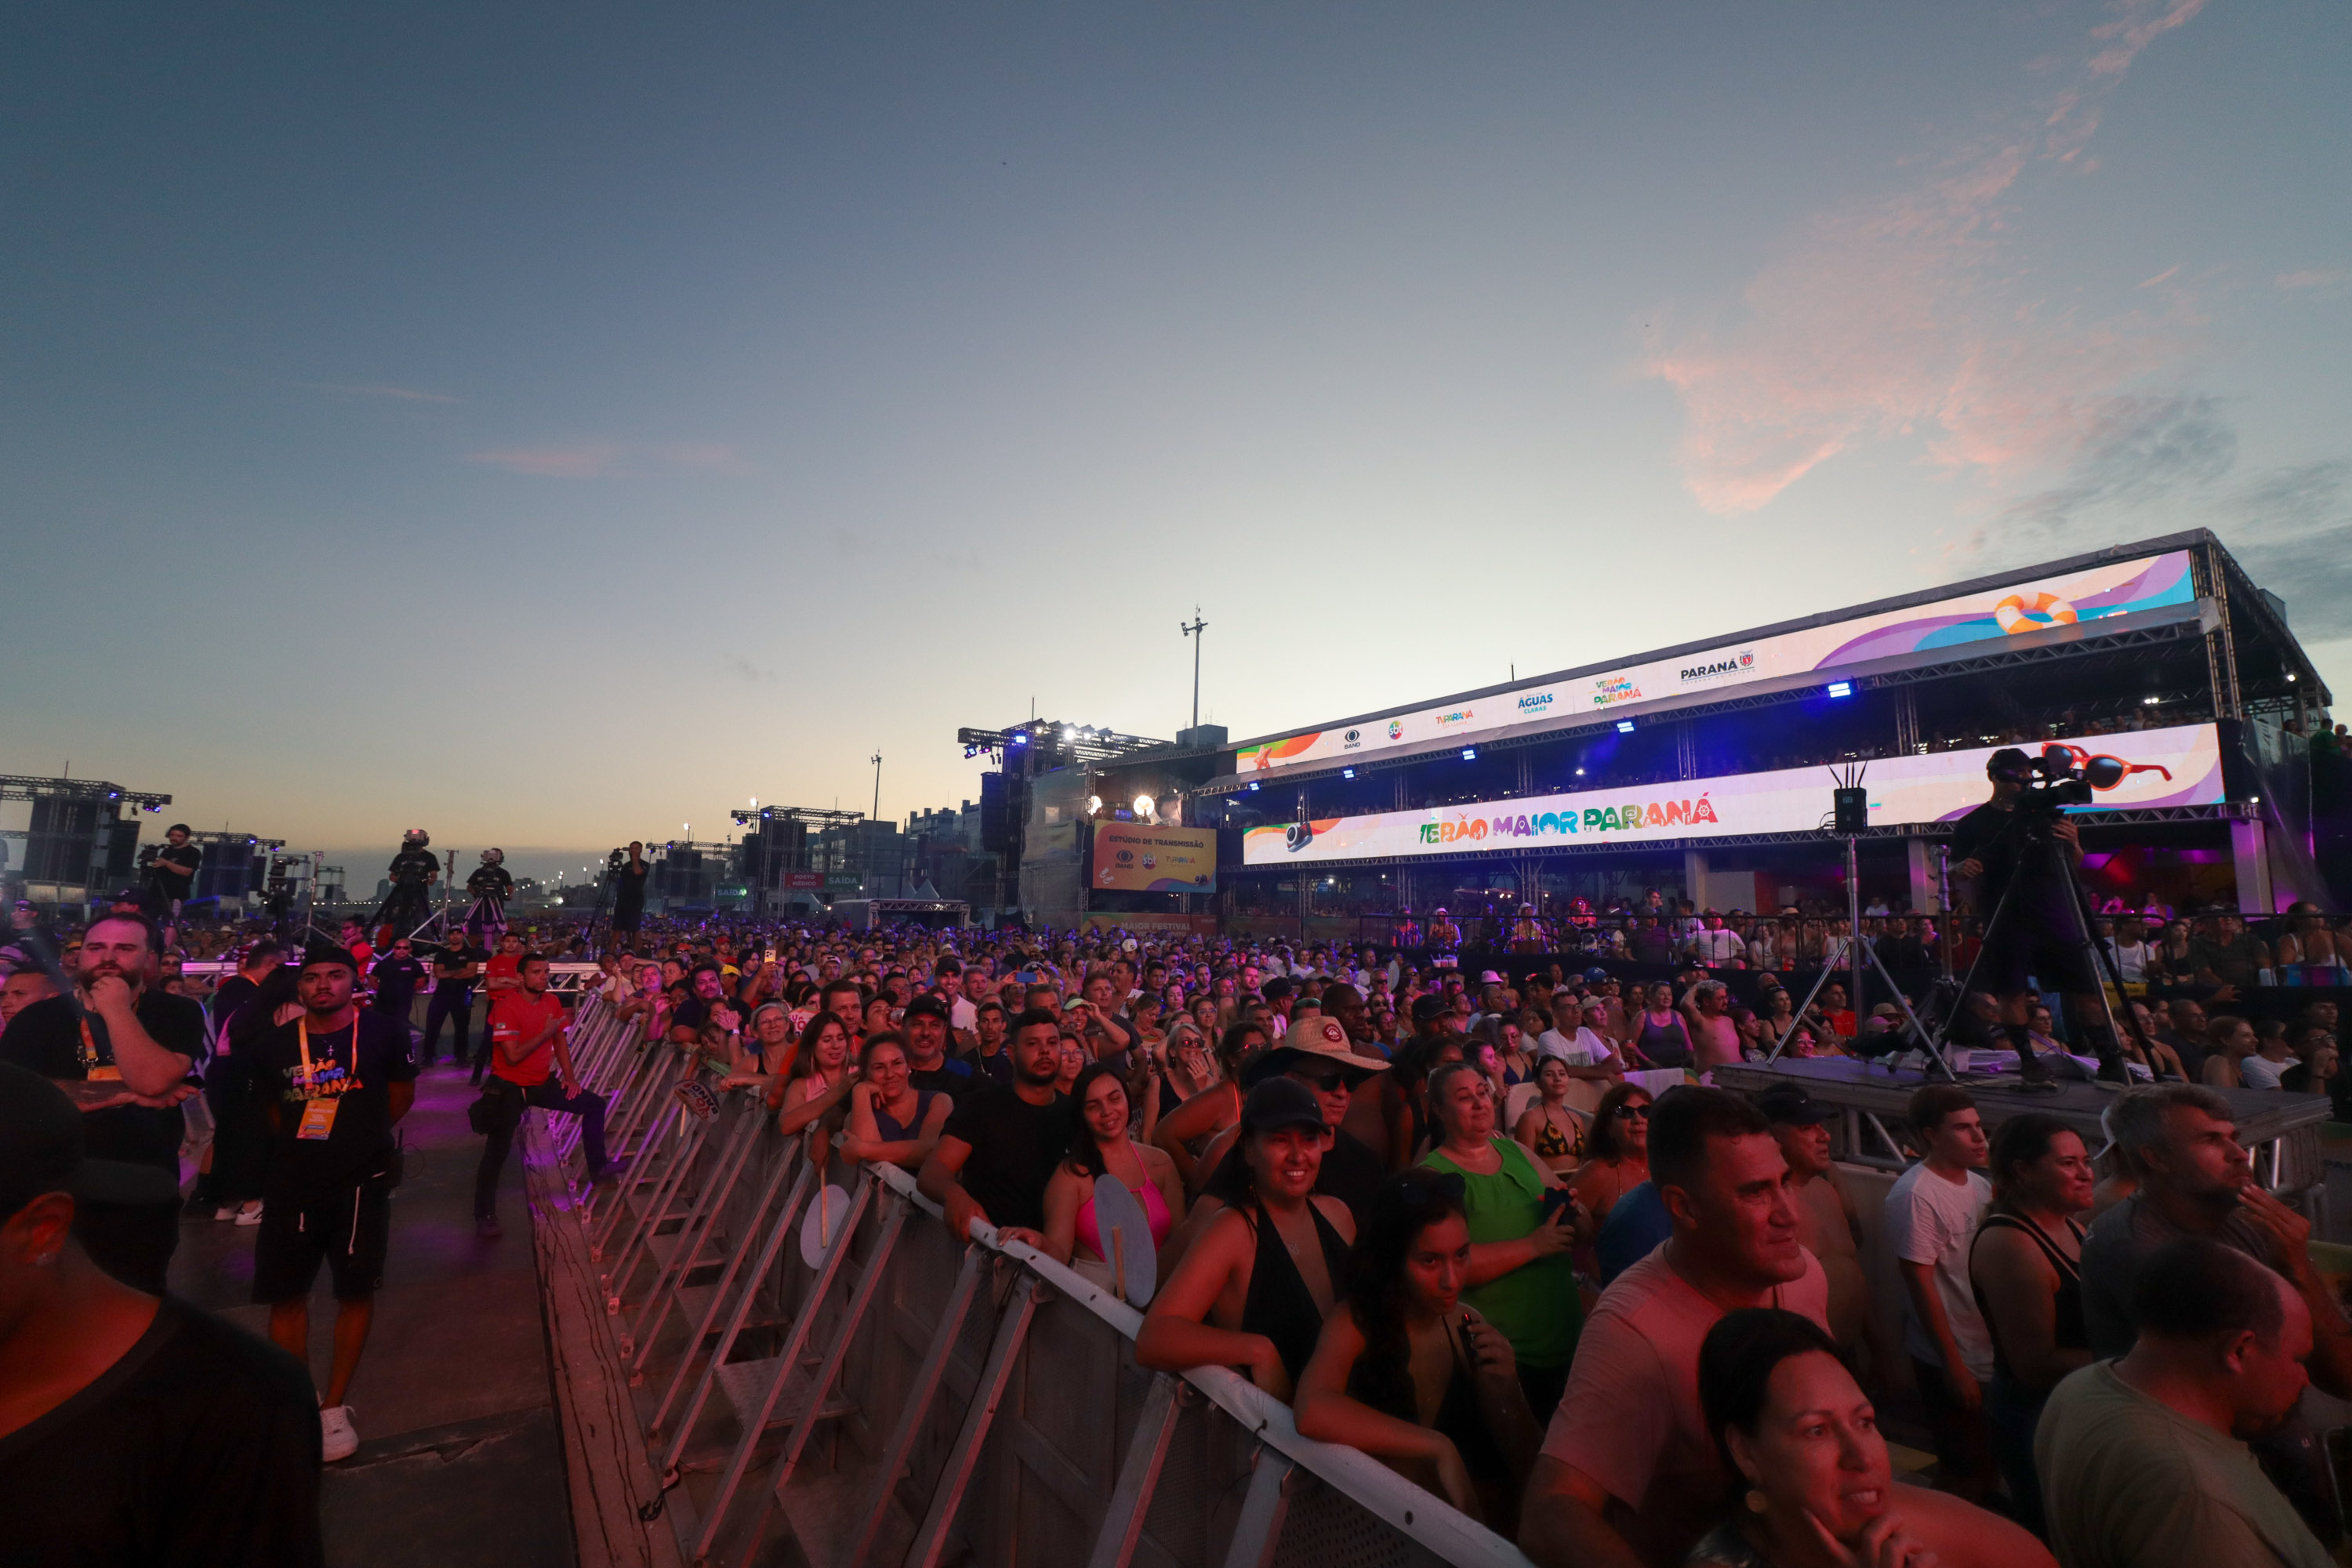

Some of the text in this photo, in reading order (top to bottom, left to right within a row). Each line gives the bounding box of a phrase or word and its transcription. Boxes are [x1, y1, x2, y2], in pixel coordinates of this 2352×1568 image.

[1681, 658, 1737, 679] PARANÁ
[1602, 683, 1632, 693] MAIOR
[1518, 693, 1553, 709] ÁGUAS
[1594, 686, 1642, 705] PARANÁ
[1524, 706, 1547, 714] CLARAS
[1389, 723, 1403, 735] sbt
[1493, 811, 1578, 837] MAIOR
[1584, 791, 1719, 832] PARANÁ
[1109, 834, 1141, 844] ESTÚDIO
[1154, 839, 1204, 849] TRANSMISSÃO
[1142, 852, 1156, 865] sbt
[828, 875, 858, 884] SAÍDA
[717, 887, 746, 896] SAÍDA
[1121, 921, 1191, 931] MAIOR FESTIVAL
